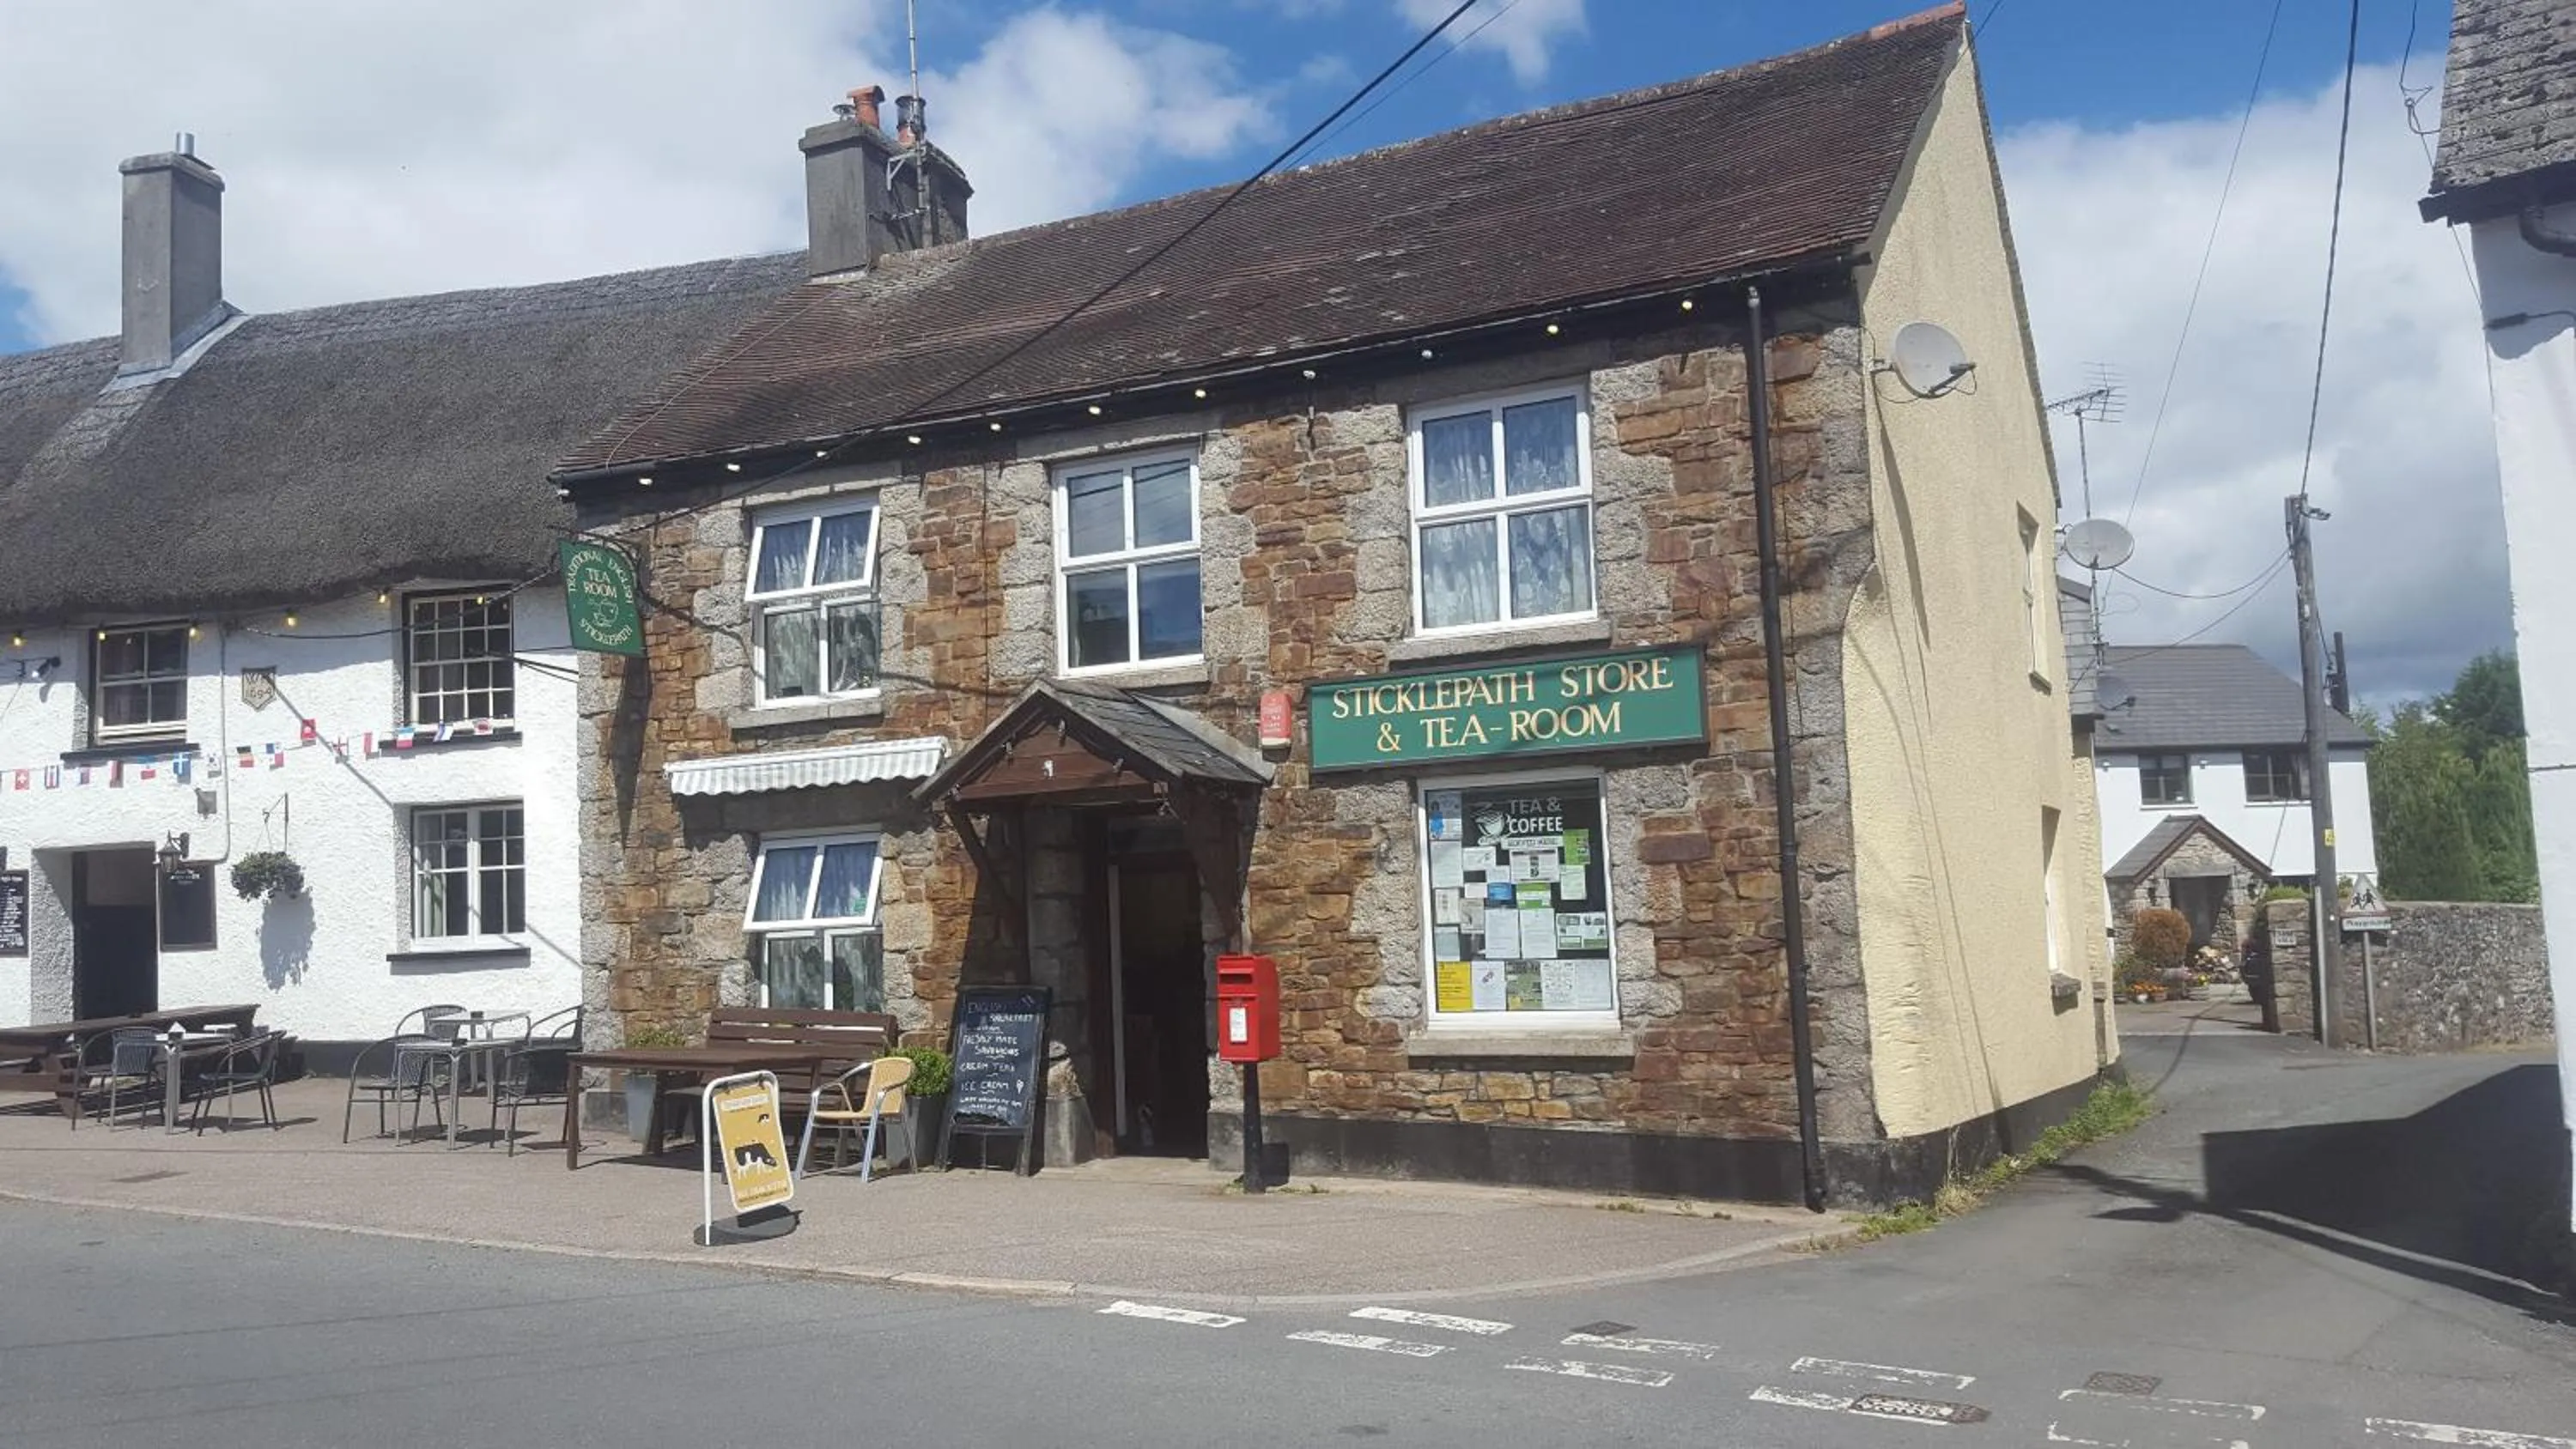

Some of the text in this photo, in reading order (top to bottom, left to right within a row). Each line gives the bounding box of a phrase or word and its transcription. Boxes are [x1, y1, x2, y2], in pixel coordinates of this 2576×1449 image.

[585, 567, 611, 584] TEA
[583, 581, 617, 598] ROOM
[1333, 658, 1674, 718] STICKLEPATH STORE
[1376, 702, 1621, 752] & TEA-ROOM
[1510, 796, 1562, 815] TEA &
[1509, 816, 1563, 834] COFFEE
